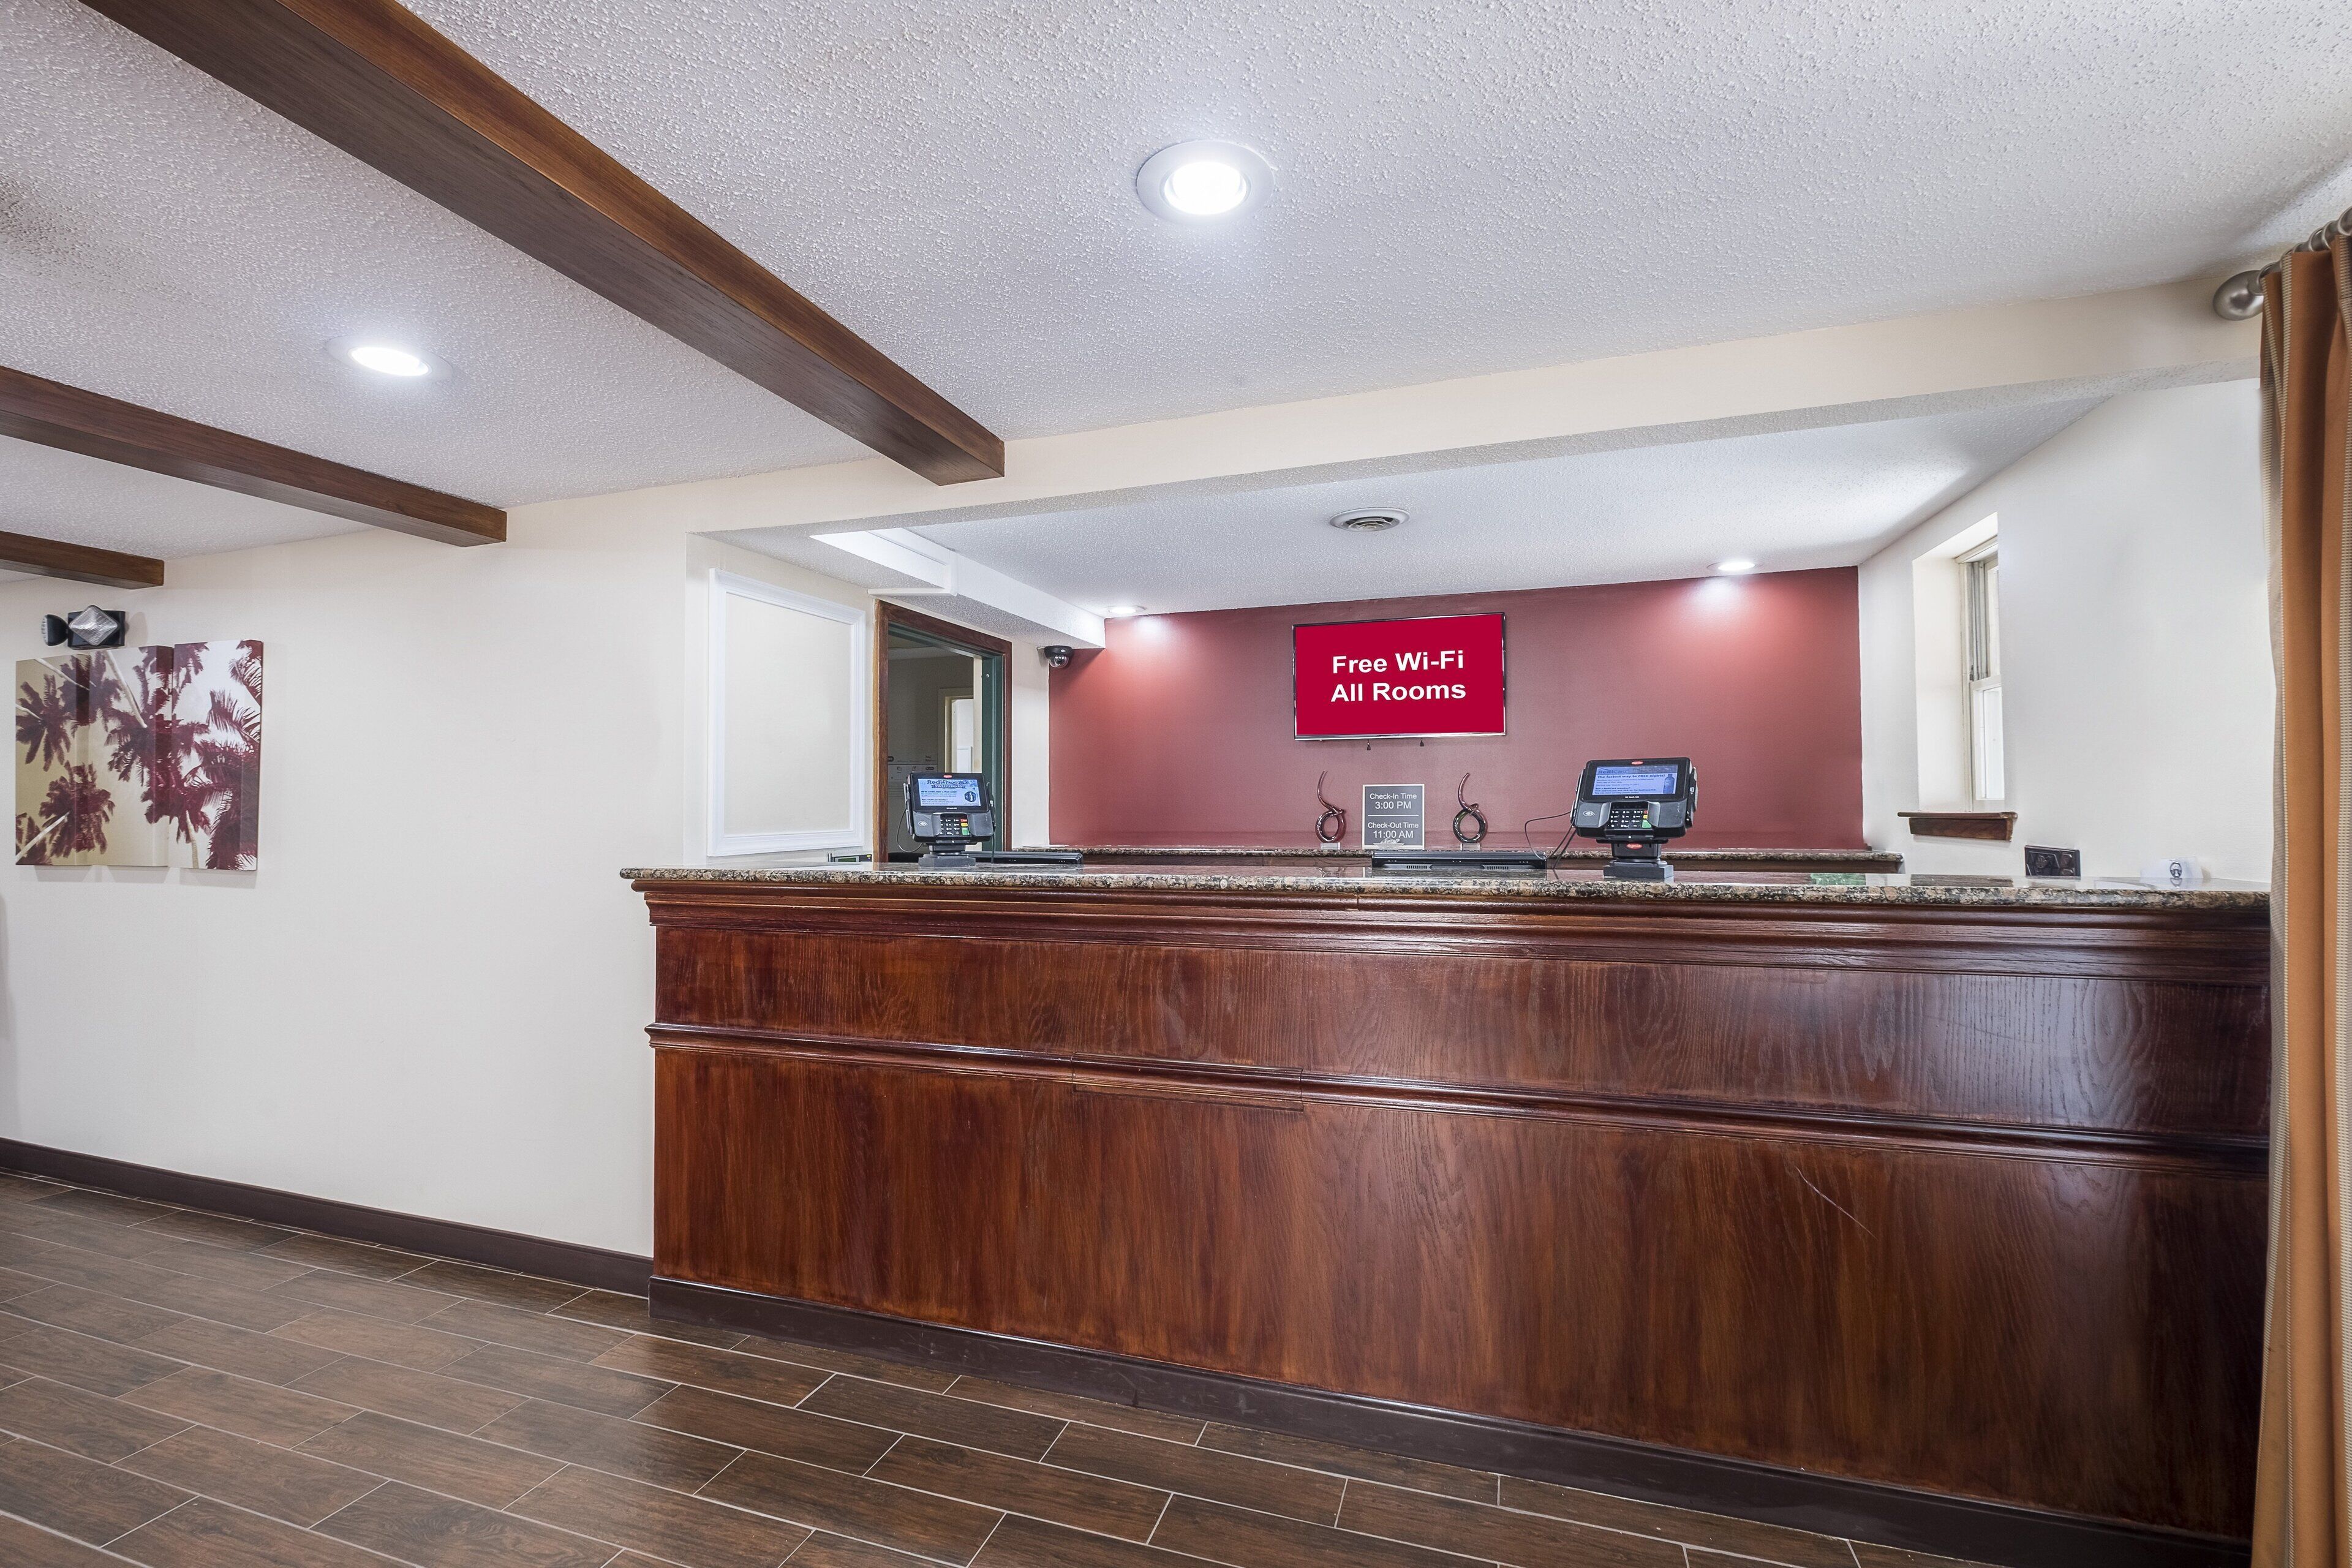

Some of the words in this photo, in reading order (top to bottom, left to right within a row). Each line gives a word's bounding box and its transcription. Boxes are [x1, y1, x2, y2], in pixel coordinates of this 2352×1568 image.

[1333, 655, 1387, 674] Free
[1395, 650, 1463, 671] Wi-Fi
[1331, 683, 1363, 702] All
[1373, 682, 1466, 701] Rooms
[1374, 801, 1394, 810] 3:00
[1373, 830, 1397, 839] 11:00
[1398, 830, 1414, 839] AM
